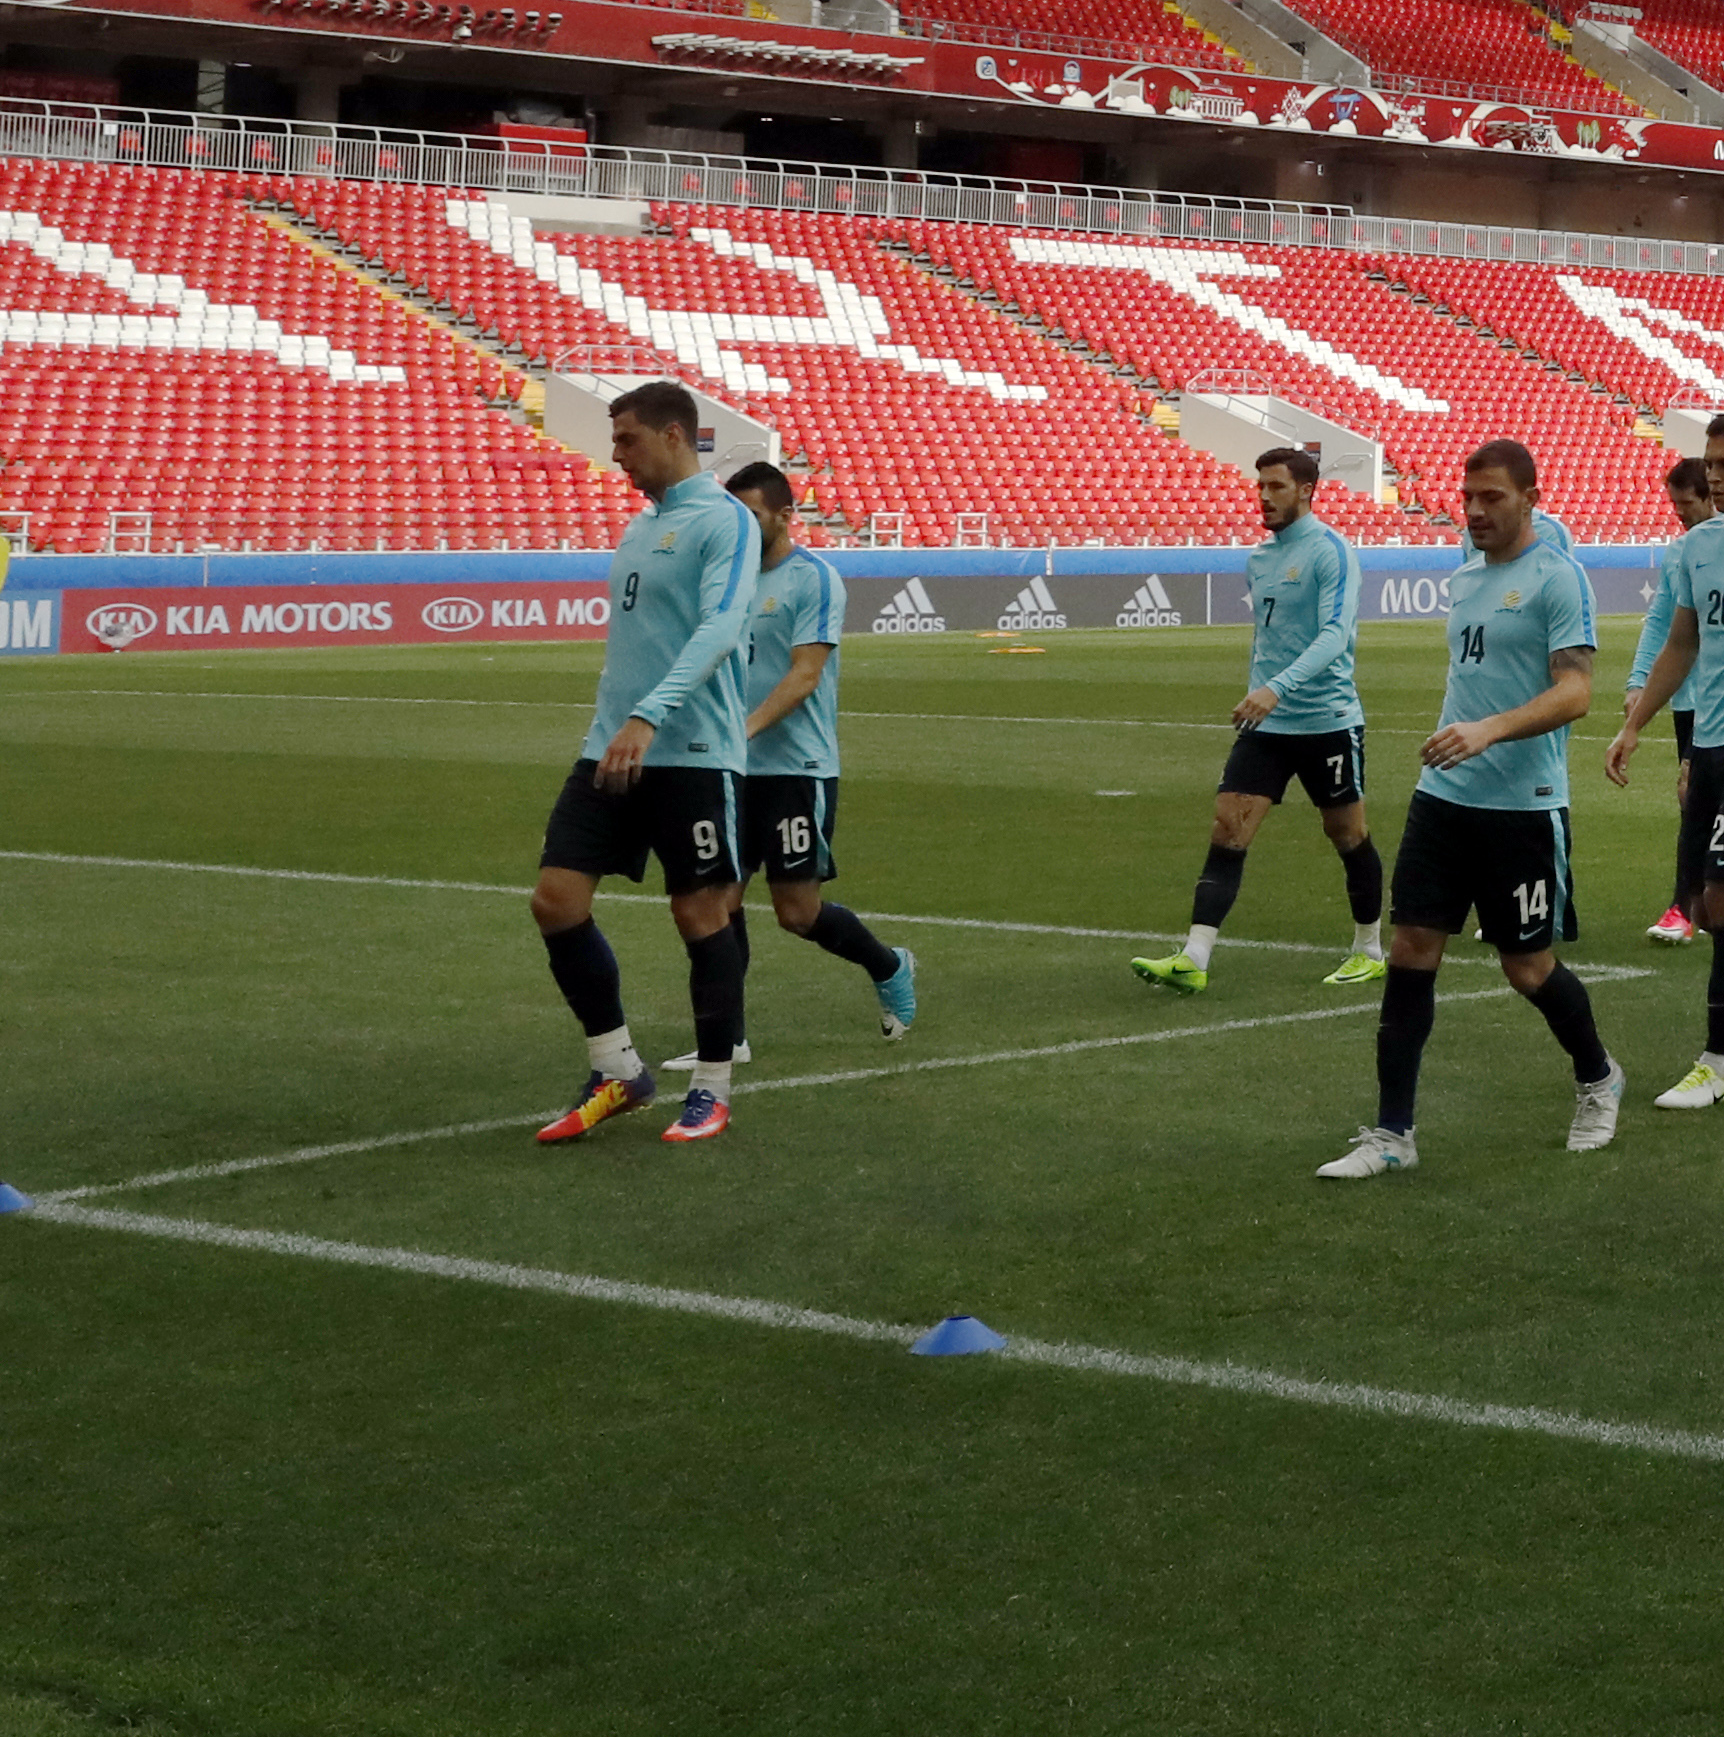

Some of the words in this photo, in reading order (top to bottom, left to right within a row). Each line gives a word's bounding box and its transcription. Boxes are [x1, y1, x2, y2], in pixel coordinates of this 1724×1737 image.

[622, 571, 640, 613] 9
[1380, 577, 1451, 614] MOS
[166, 604, 230, 636] KIA
[241, 601, 394, 635] MOTORS
[432, 604, 473, 625] KIA
[491, 599, 548, 628] KIA
[872, 611, 946, 634] adidas
[998, 609, 1067, 631] adidas
[1116, 607, 1182, 628] adidas
[1262, 596, 1277, 628] 7
[1459, 624, 1485, 665] 14
[1325, 753, 1344, 785] 7
[692, 819, 720, 860] 9
[776, 815, 811, 855] 16
[1512, 878, 1549, 925] 14
